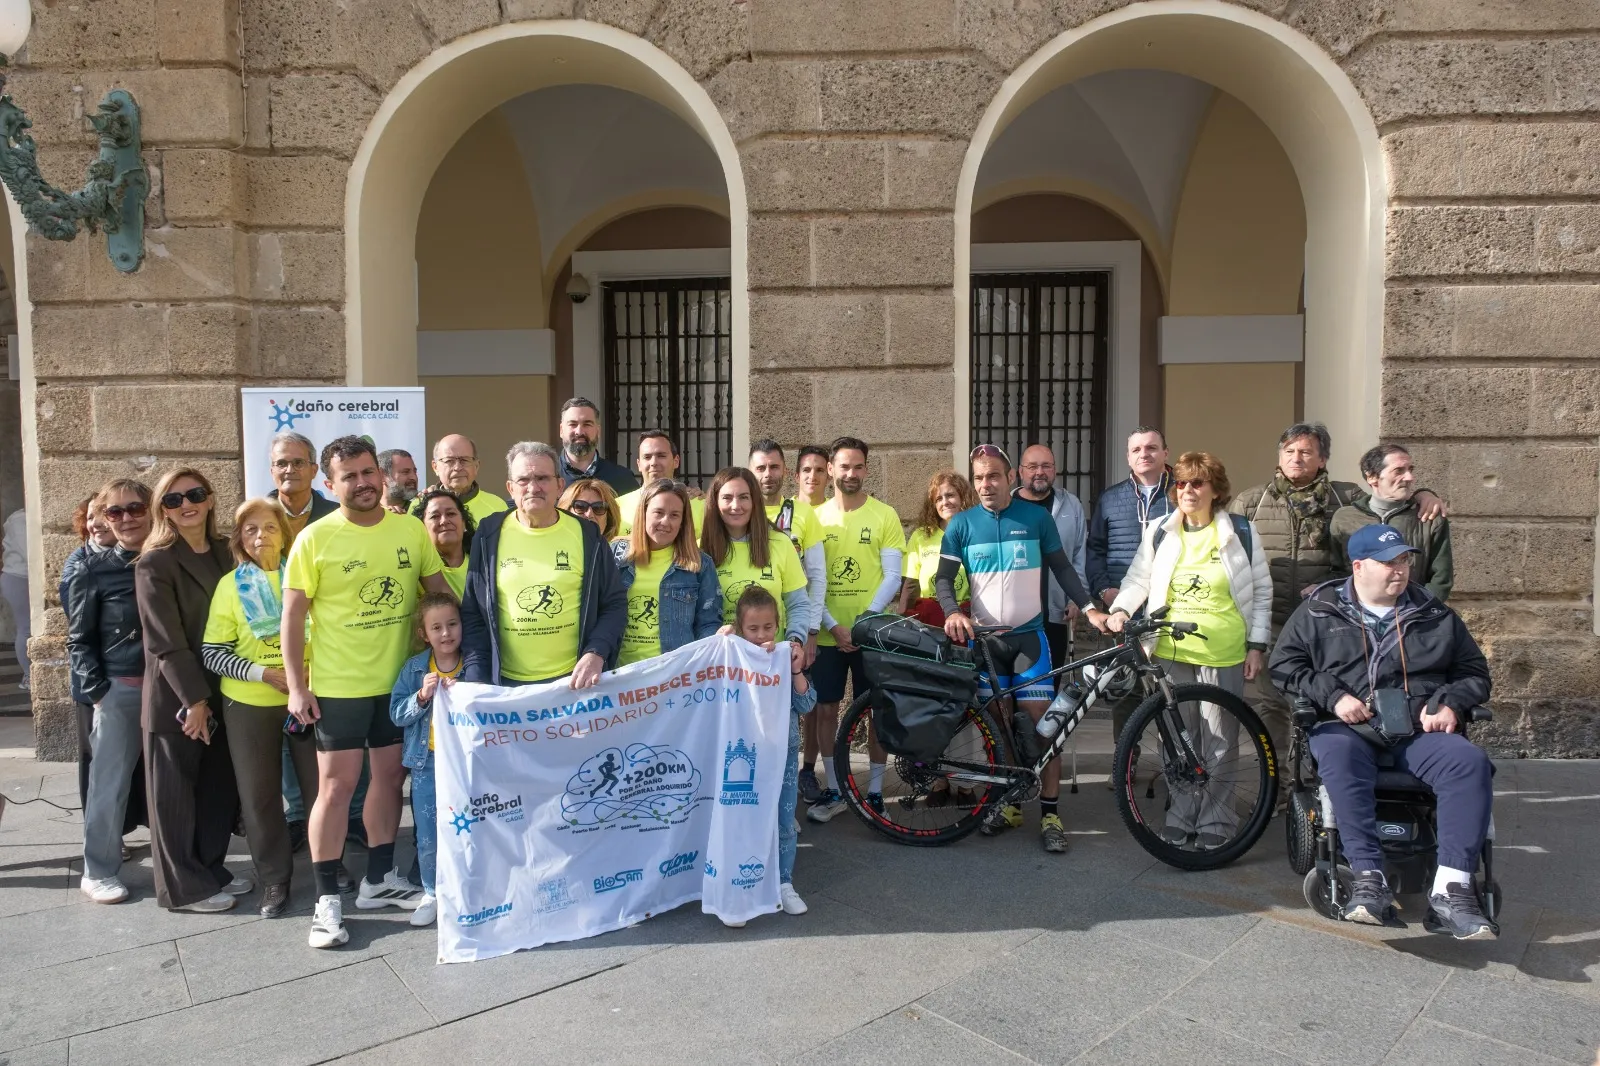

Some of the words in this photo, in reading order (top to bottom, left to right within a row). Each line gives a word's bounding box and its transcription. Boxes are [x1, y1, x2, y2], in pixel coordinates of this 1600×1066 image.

[295, 399, 334, 412] daño
[338, 399, 399, 412] cerebral
[378, 412, 399, 420] CÁDIZ
[475, 711, 523, 726] VIDA
[526, 695, 614, 722] SALVADA
[618, 672, 692, 707] MERECE
[695, 665, 726, 683] SER
[727, 666, 781, 687] VIVIDA
[483, 728, 538, 748] RETO
[545, 701, 659, 740] SOLIDARIO
[665, 698, 676, 709] +
[682, 687, 717, 708] 200
[1259, 734, 1276, 777] MAXXIS
[623, 761, 687, 785] +200KM
[619, 786, 634, 794] POR
[619, 786, 656, 802] CEREBRAL
[655, 782, 693, 792] ADQUIRIDO
[667, 864, 695, 878] LABORAL
